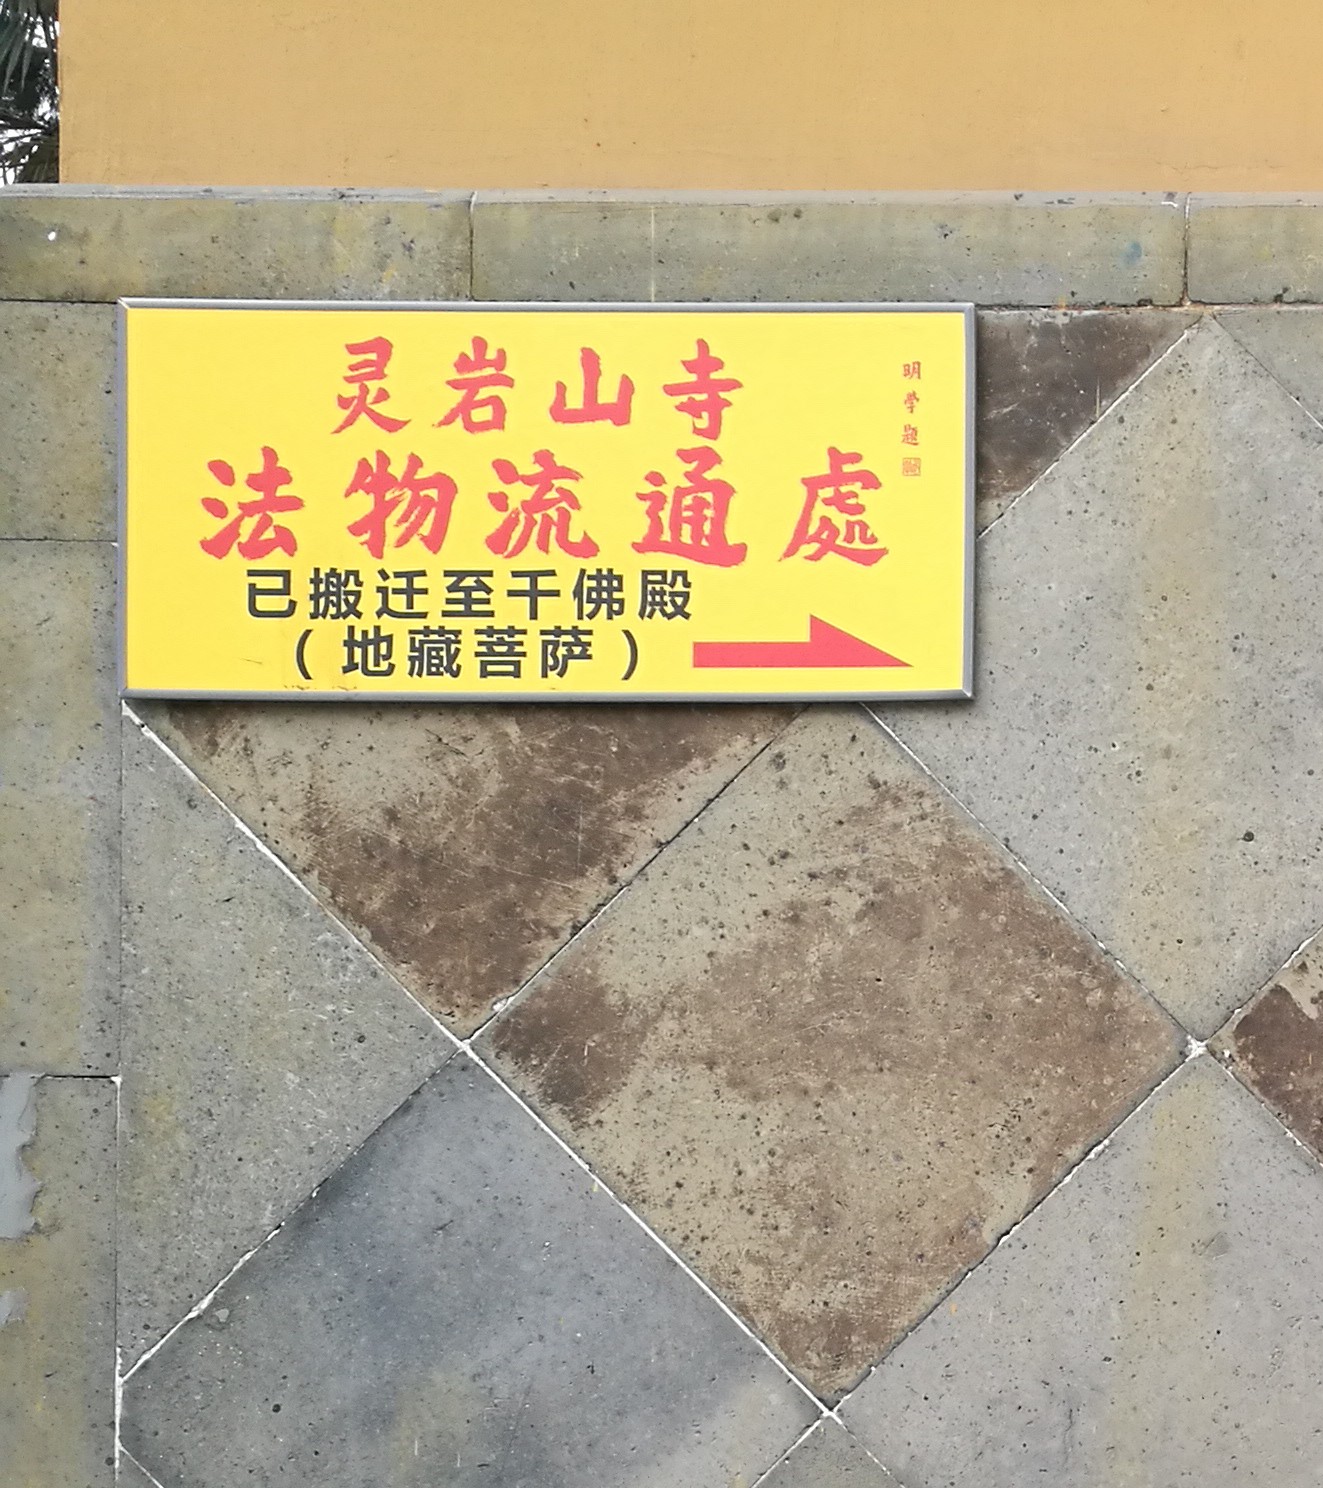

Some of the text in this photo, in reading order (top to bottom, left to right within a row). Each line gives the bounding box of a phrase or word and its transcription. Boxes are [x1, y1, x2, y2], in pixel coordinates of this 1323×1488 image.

[331, 334, 743, 442] 灵岩山寺
[245, 566, 693, 622] 已搬迁至千佛殿
